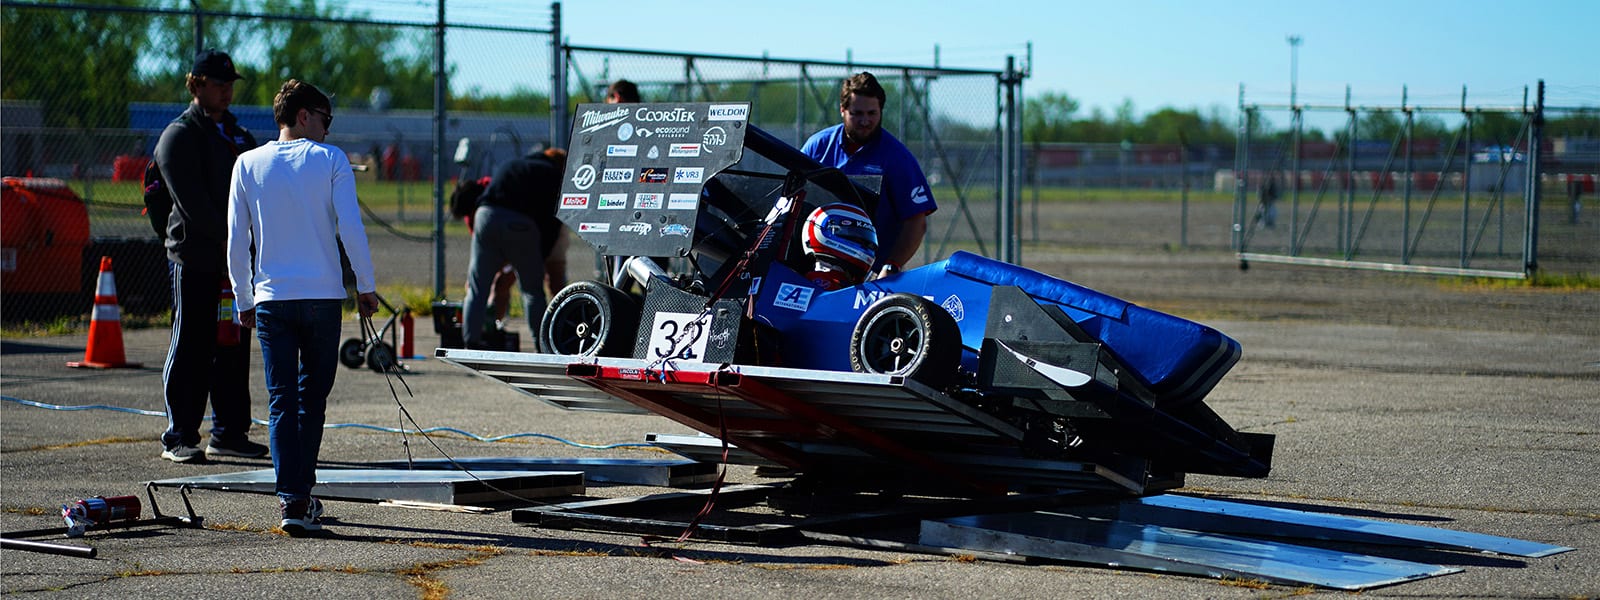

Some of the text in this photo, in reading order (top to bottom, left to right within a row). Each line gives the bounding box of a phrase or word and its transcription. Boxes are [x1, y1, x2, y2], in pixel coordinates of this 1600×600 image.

[581, 106, 629, 128] Milwaukee
[710, 107, 746, 117] WELDON
[655, 125, 690, 134] ecosound
[685, 171, 699, 179] VR3
[778, 285, 811, 305] SAE
[655, 320, 707, 359] 32
